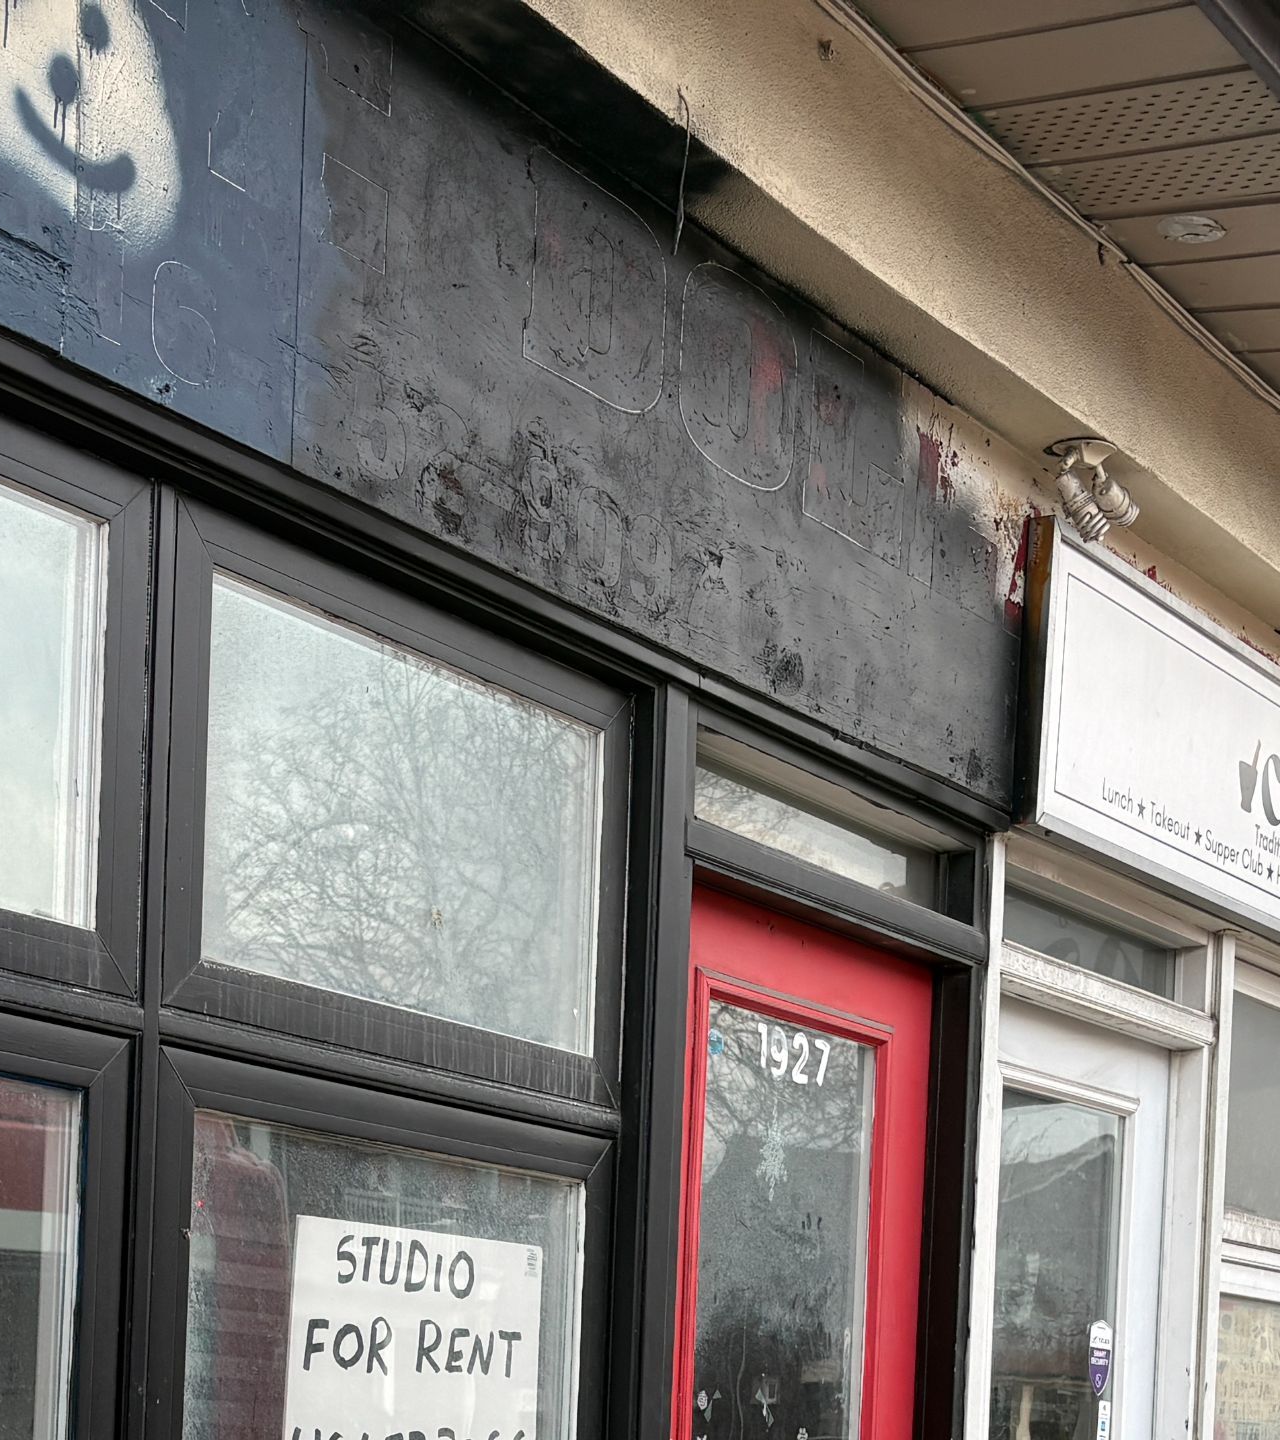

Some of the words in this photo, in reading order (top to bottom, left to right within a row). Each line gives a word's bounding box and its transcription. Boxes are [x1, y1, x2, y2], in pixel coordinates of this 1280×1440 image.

[1102, 777, 1134, 813] Lunch
[1150, 801, 1190, 841] Takeout
[1205, 829, 1240, 866] Supper
[1242, 849, 1264, 876] Club
[757, 1022, 831, 1087] 1927
[336, 1234, 475, 1299] STUDIO
[302, 1316, 393, 1376] FOR
[415, 1318, 522, 1378] RENT
